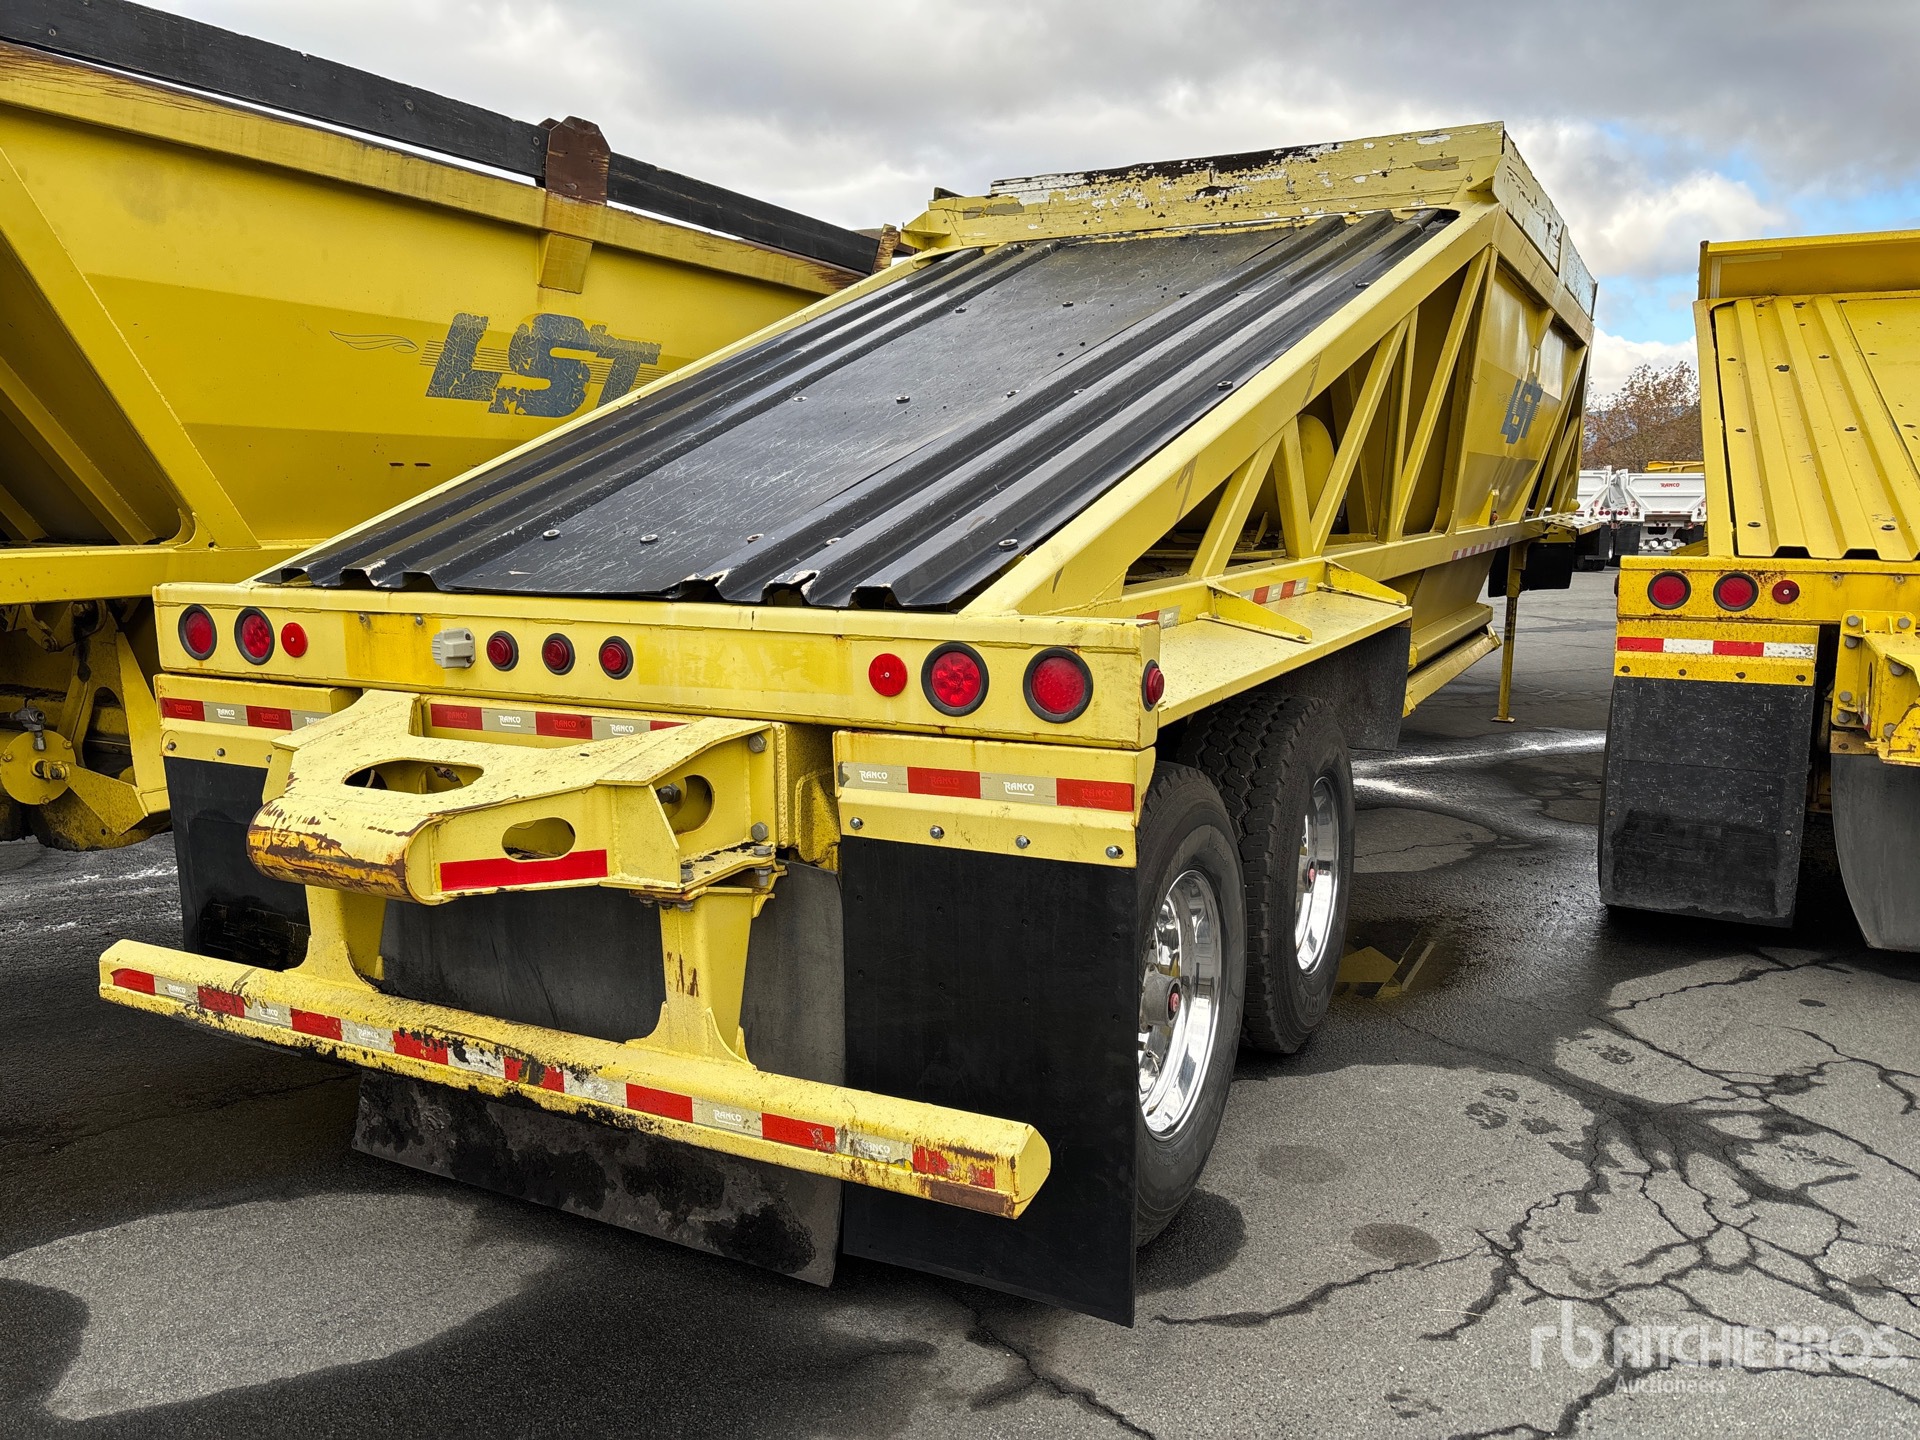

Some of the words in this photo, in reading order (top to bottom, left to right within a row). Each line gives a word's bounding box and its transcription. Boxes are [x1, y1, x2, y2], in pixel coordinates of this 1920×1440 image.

[425, 312, 662, 418] LST
[216, 708, 235, 720] RANCO
[498, 715, 521, 727] RANCO
[553, 719, 577, 731] RANCO
[609, 723, 634, 735] RANCO
[859, 770, 888, 784] RANCO
[929, 775, 959, 789] RANCO
[1002, 781, 1034, 796] RANCO
[1081, 788, 1114, 803] RANCO
[713, 1110, 742, 1127] RANCO
